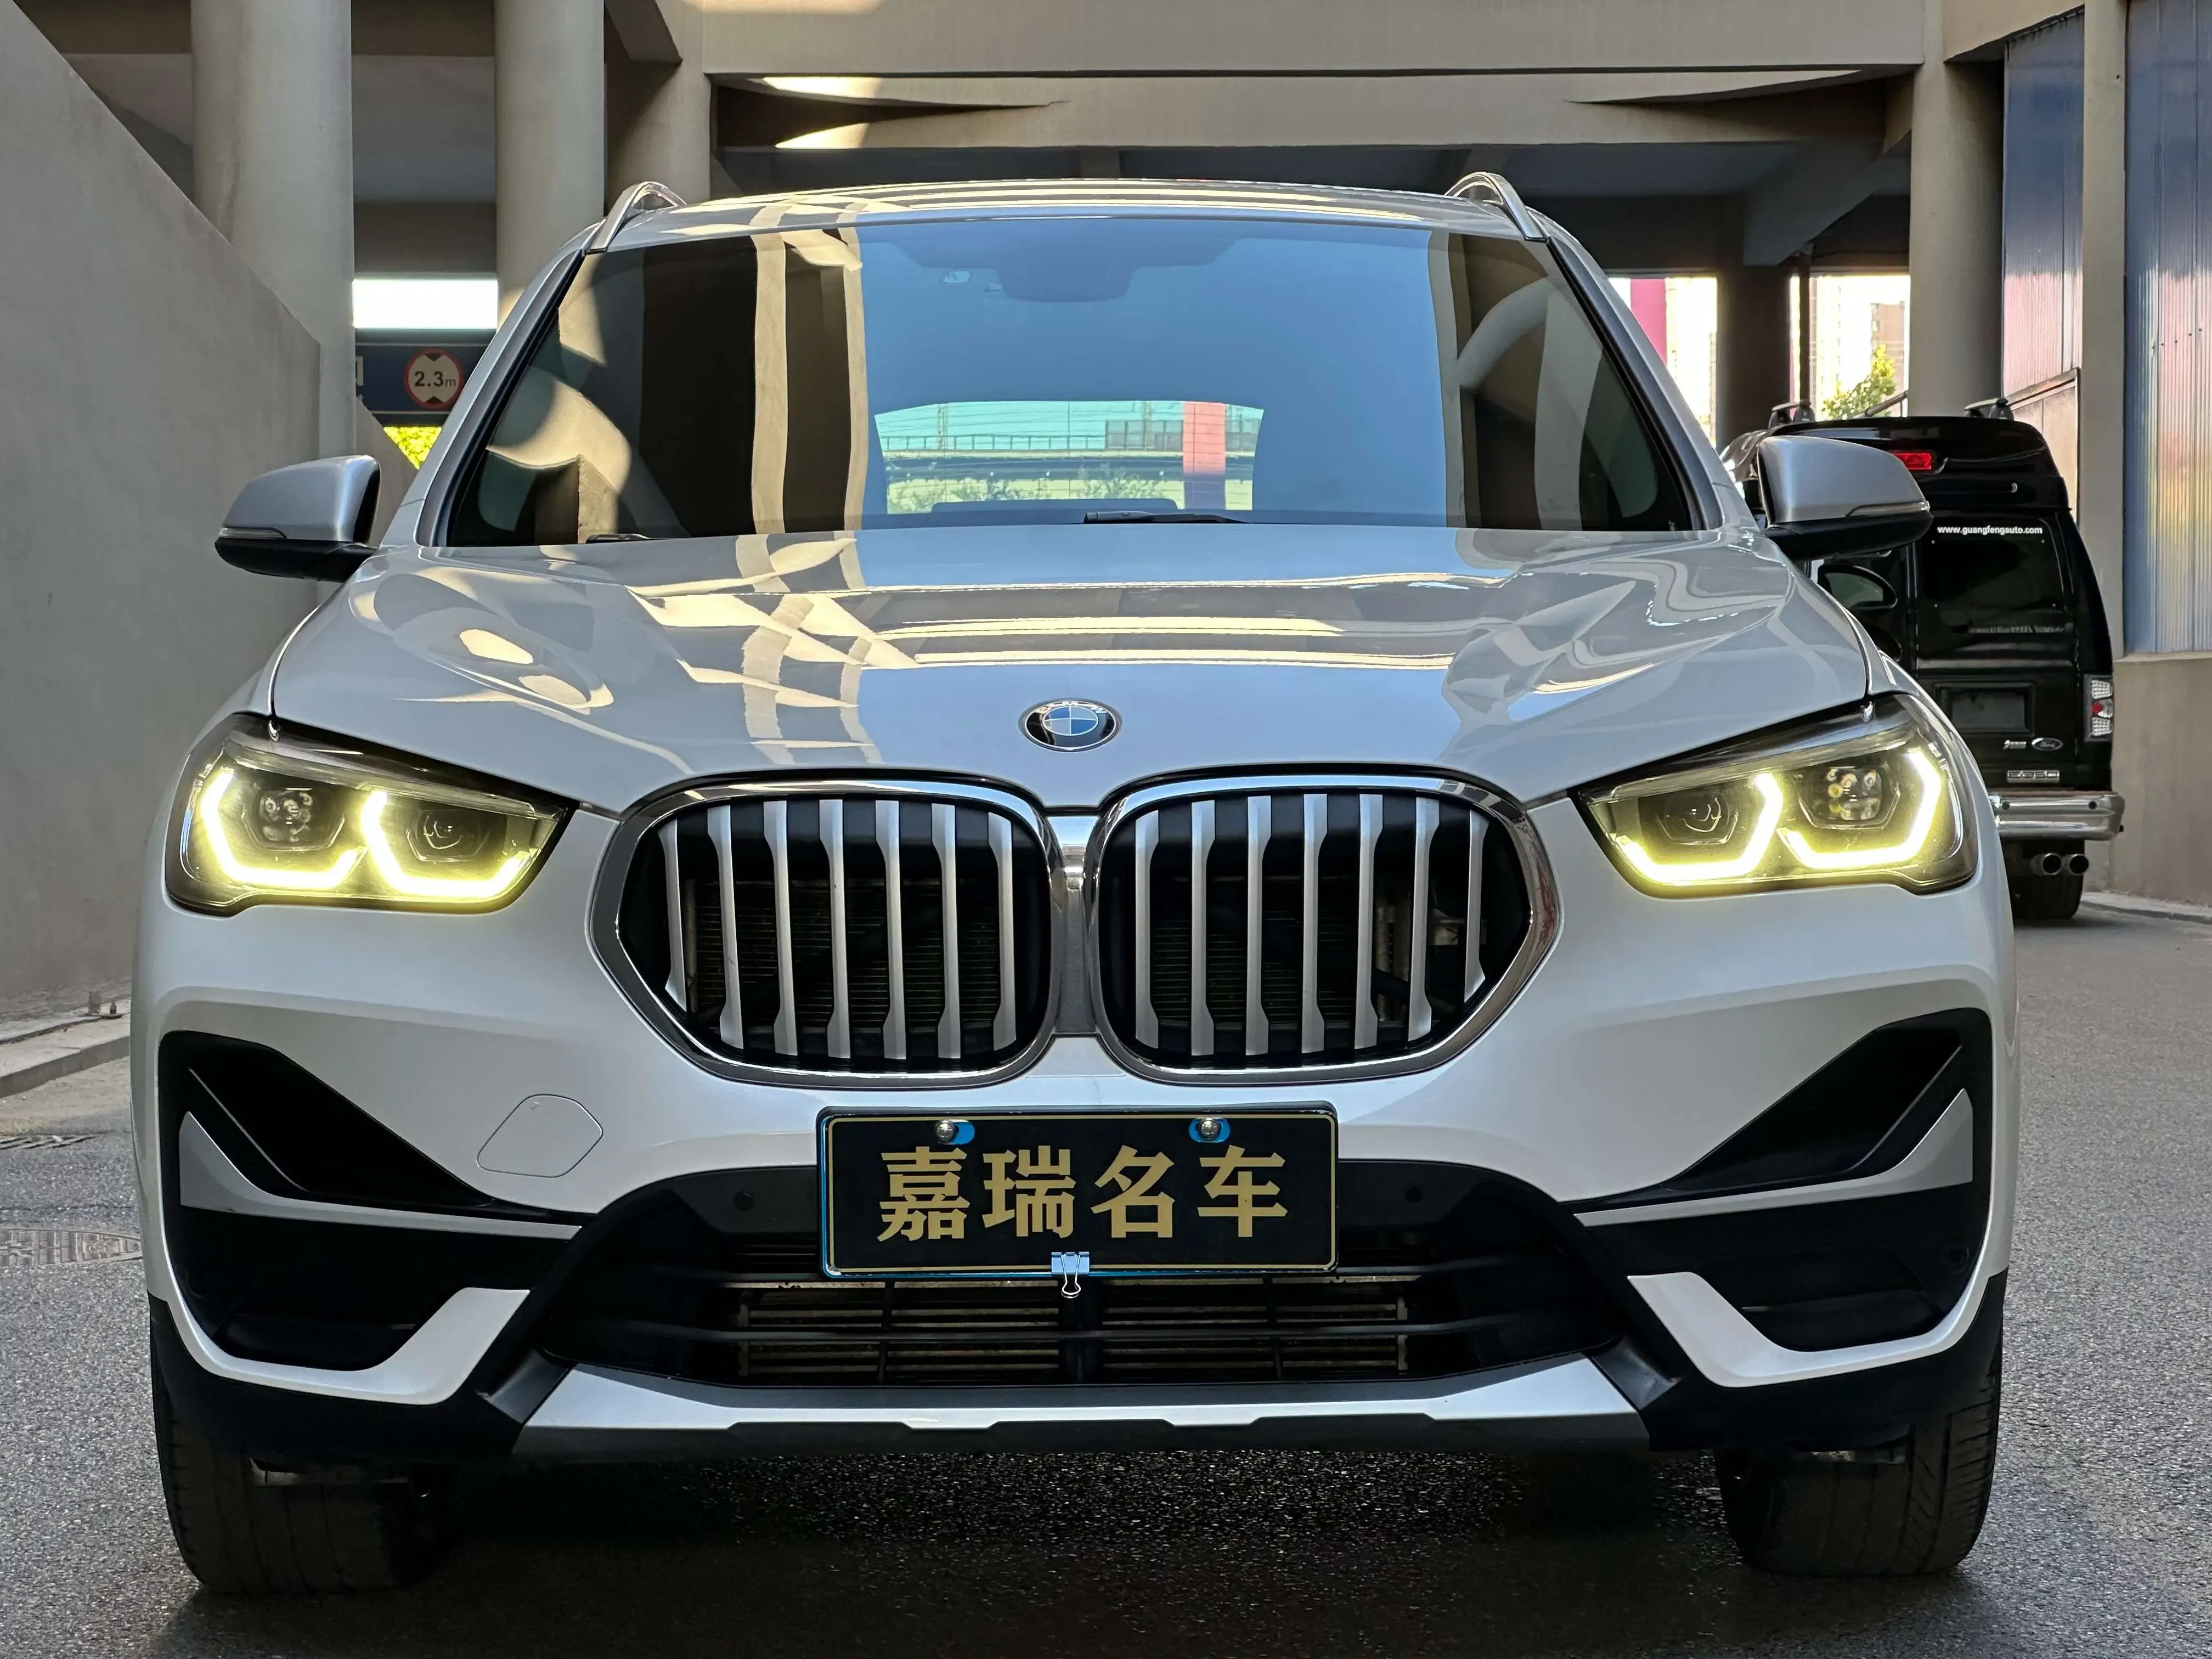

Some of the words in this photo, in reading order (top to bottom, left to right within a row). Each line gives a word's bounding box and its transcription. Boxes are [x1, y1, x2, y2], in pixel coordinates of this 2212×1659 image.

[414, 371, 456, 387] 2.3m
[1937, 525, 2043, 535] www.guangfengauto.com
[877, 1144, 1288, 1242] 嘉瑞名车
